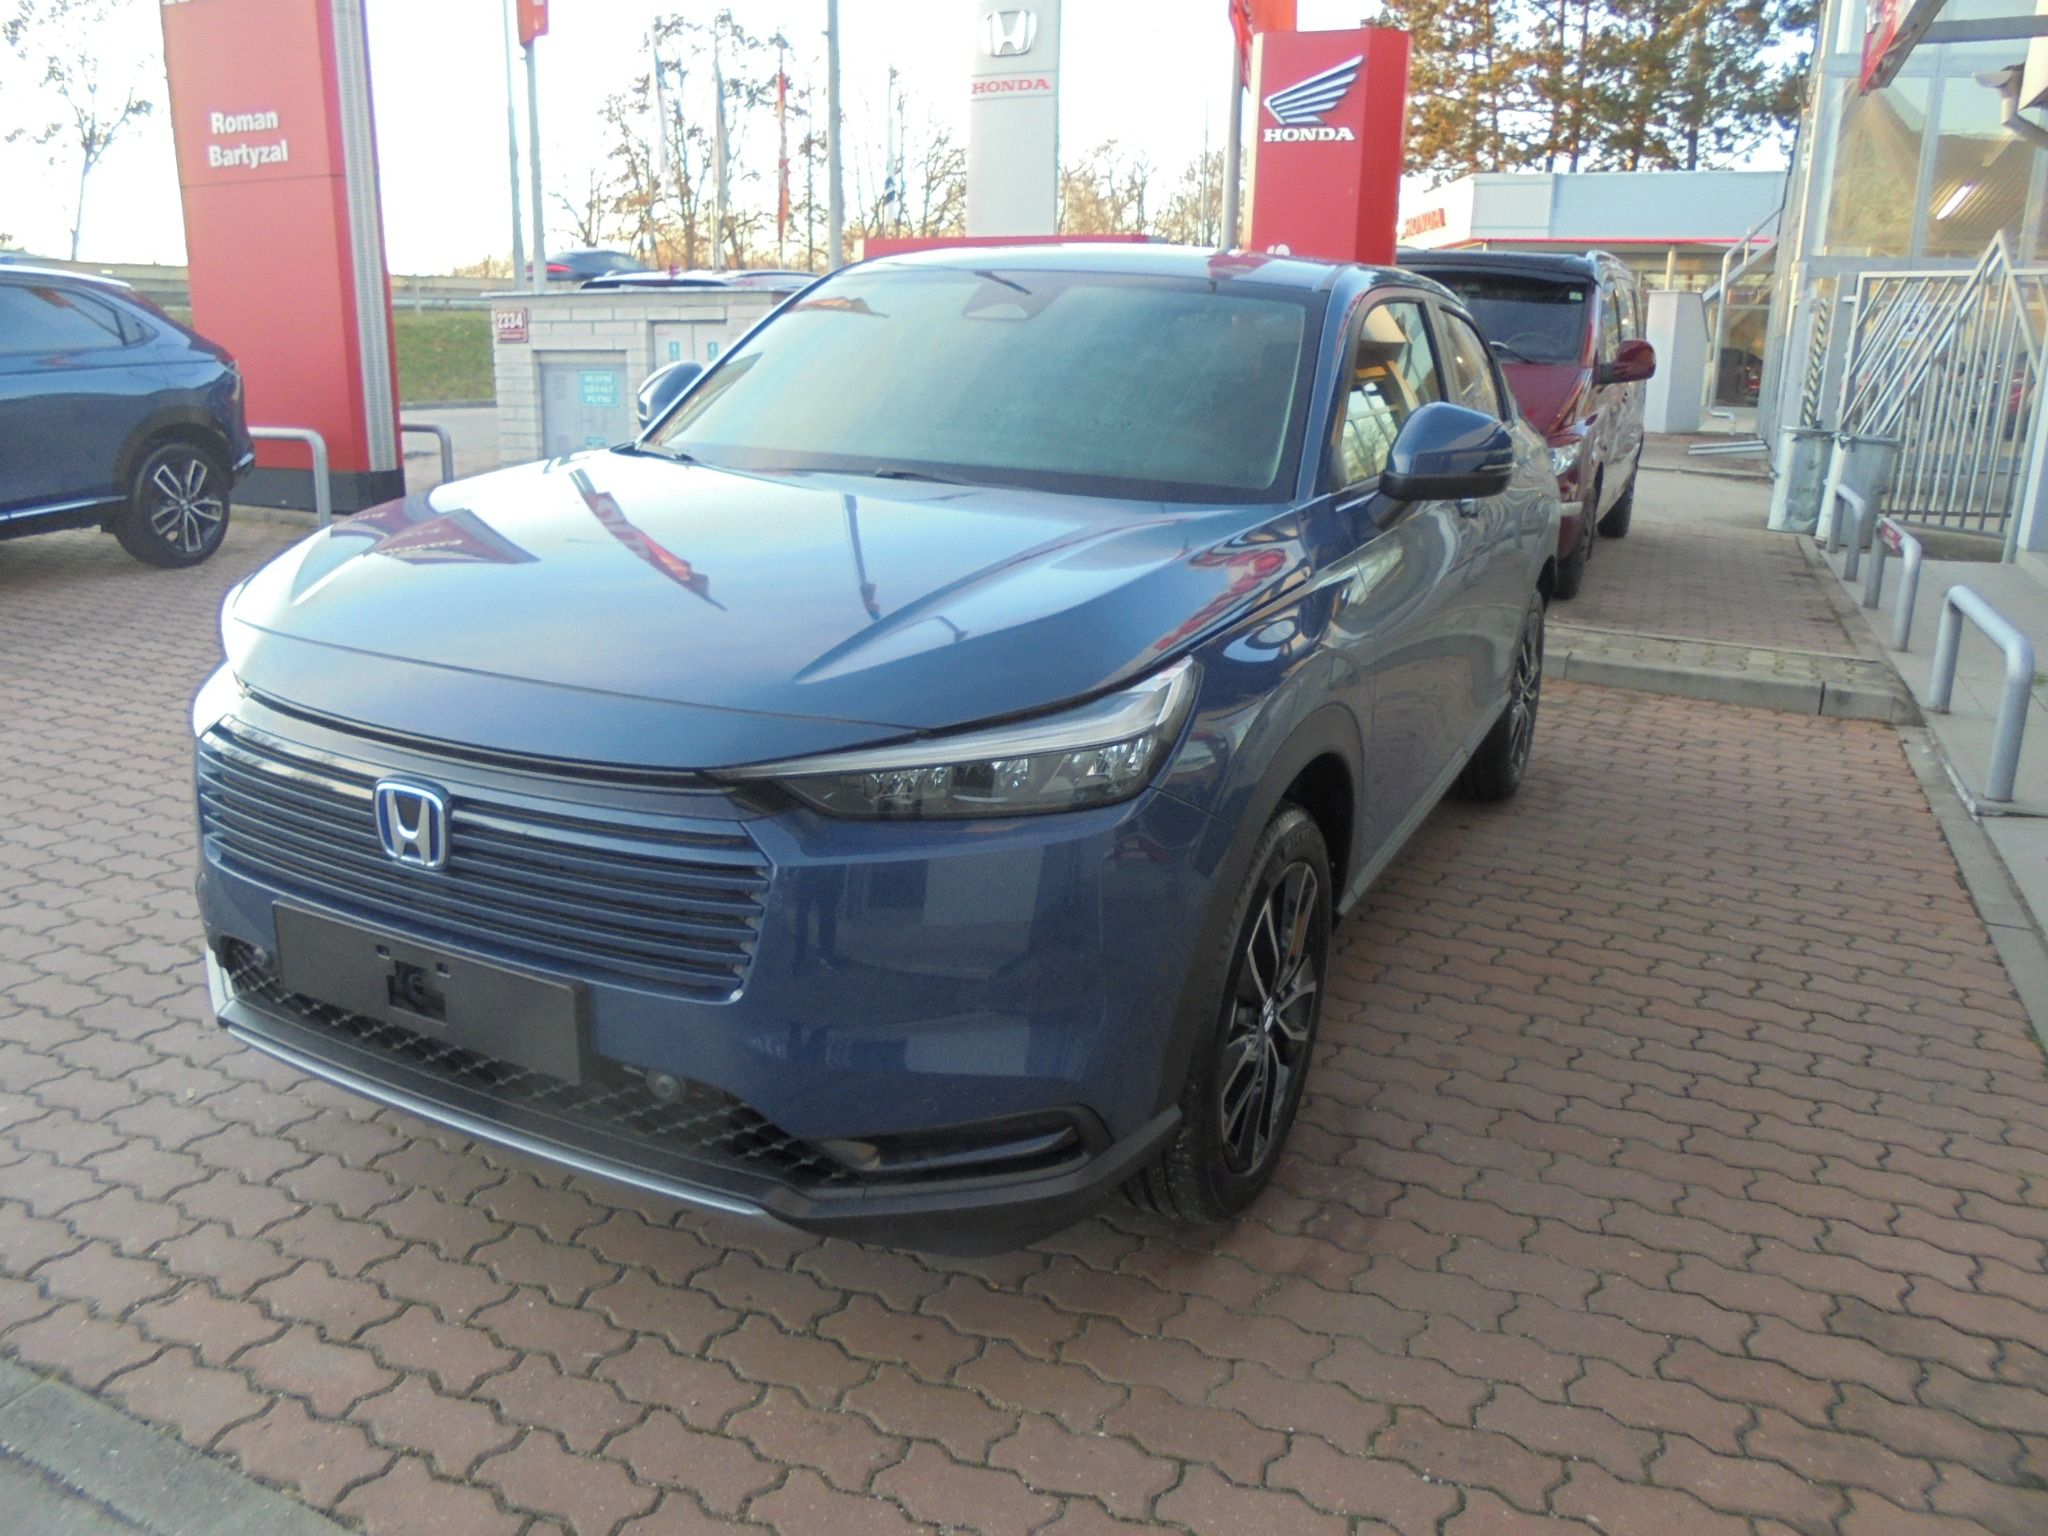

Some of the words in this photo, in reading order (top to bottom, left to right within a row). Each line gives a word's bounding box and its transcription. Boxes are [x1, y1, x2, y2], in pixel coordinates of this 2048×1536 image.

[971, 79, 1050, 94] HONDA
[210, 111, 279, 134] Roman
[1263, 127, 1355, 142] HONDA
[208, 139, 288, 168] Bartyzal
[496, 312, 523, 328] 2334
